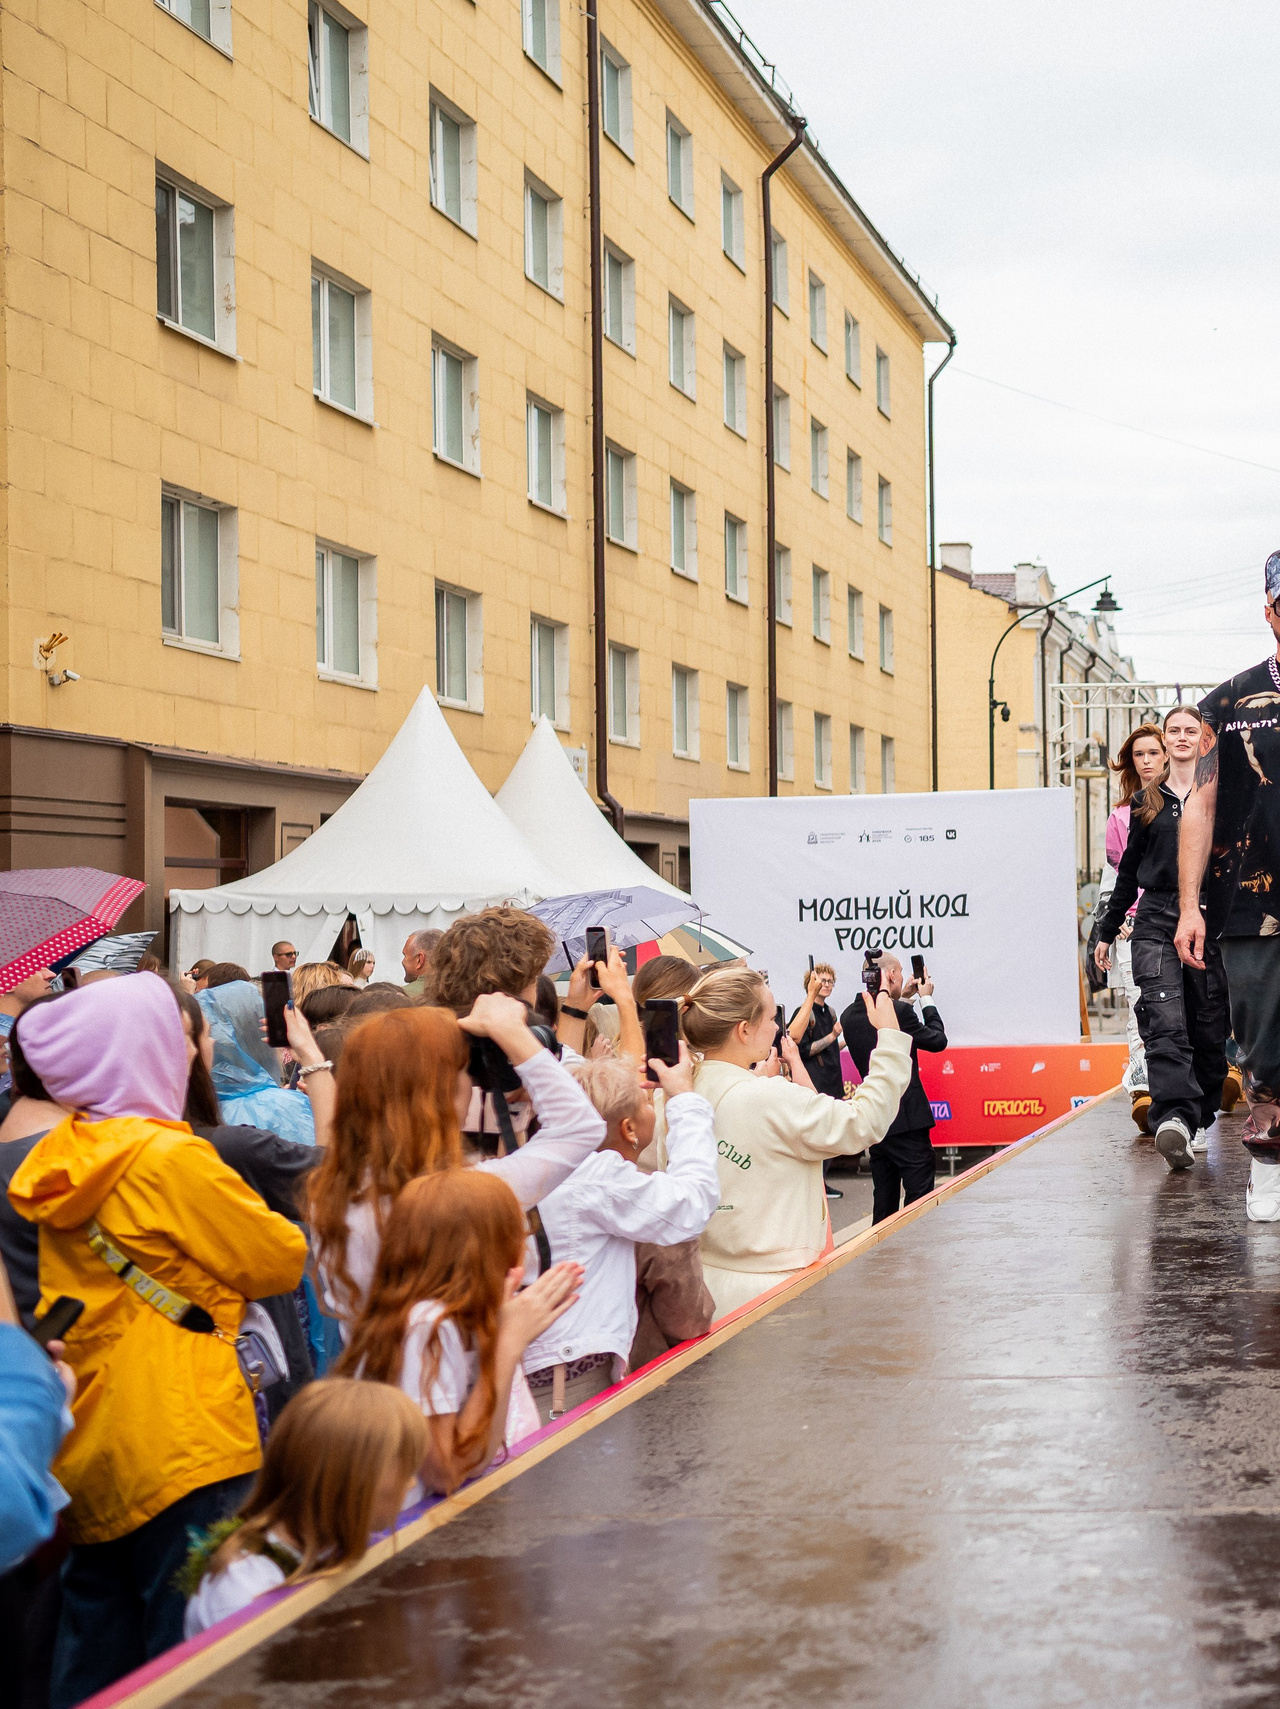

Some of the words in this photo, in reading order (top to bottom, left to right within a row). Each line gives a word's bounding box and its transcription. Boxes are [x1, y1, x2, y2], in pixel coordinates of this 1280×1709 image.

[1225, 720, 1249, 732] ASIA
[798, 889, 912, 922] МОДНЫЙ
[920, 893, 970, 918] КОД
[834, 925, 935, 951] РОССИИ
[983, 1099, 1045, 1116] ГОРДОСТЬ
[717, 1139, 752, 1171] Club
